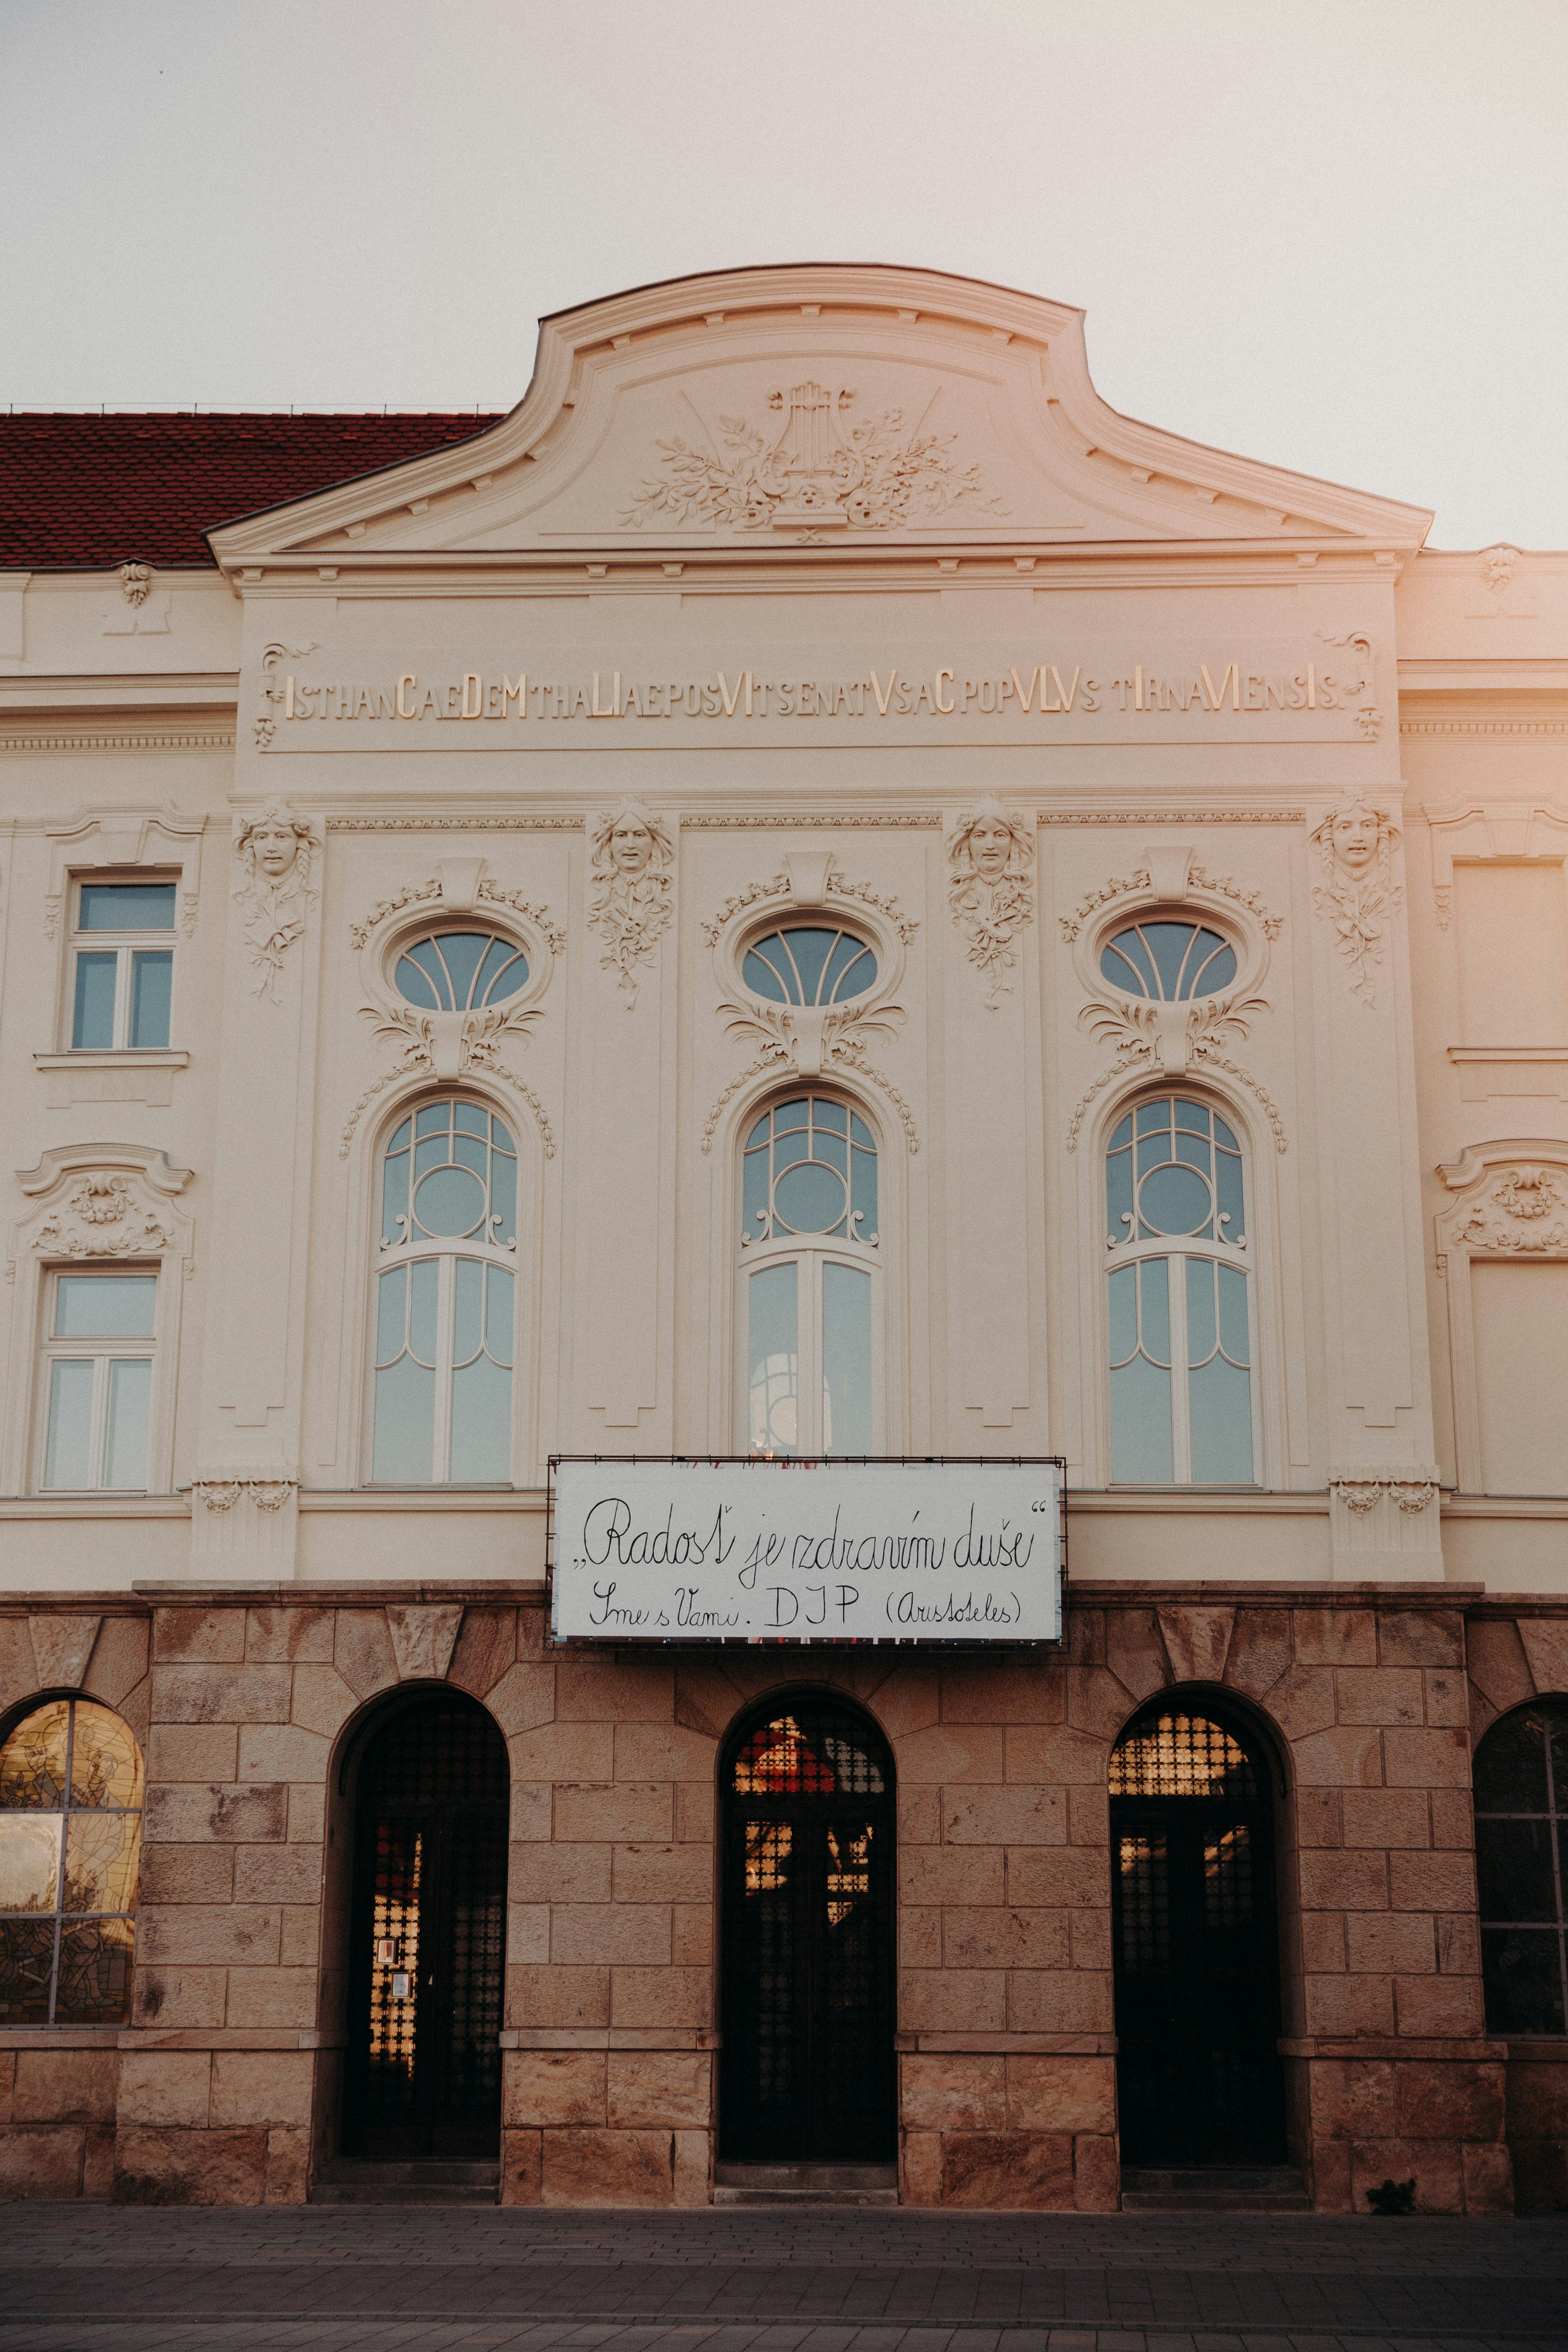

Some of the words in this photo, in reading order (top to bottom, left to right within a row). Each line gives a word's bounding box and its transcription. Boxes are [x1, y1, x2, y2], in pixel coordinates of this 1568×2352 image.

[419, 673, 527, 720] AEDEM
[531, 671, 661, 719] THALIAE
[664, 671, 773, 717] POSVIT
[777, 669, 913, 717] SENATVS
[914, 669, 954, 715] AC
[959, 665, 1101, 714] POPVLVS
[738, 1513, 786, 1589] je
[792, 1504, 946, 1570] zdravím
[589, 1581, 649, 1625] Sme
[654, 1609, 670, 1626] s
[886, 1592, 1020, 1624] (Aristoteles)
